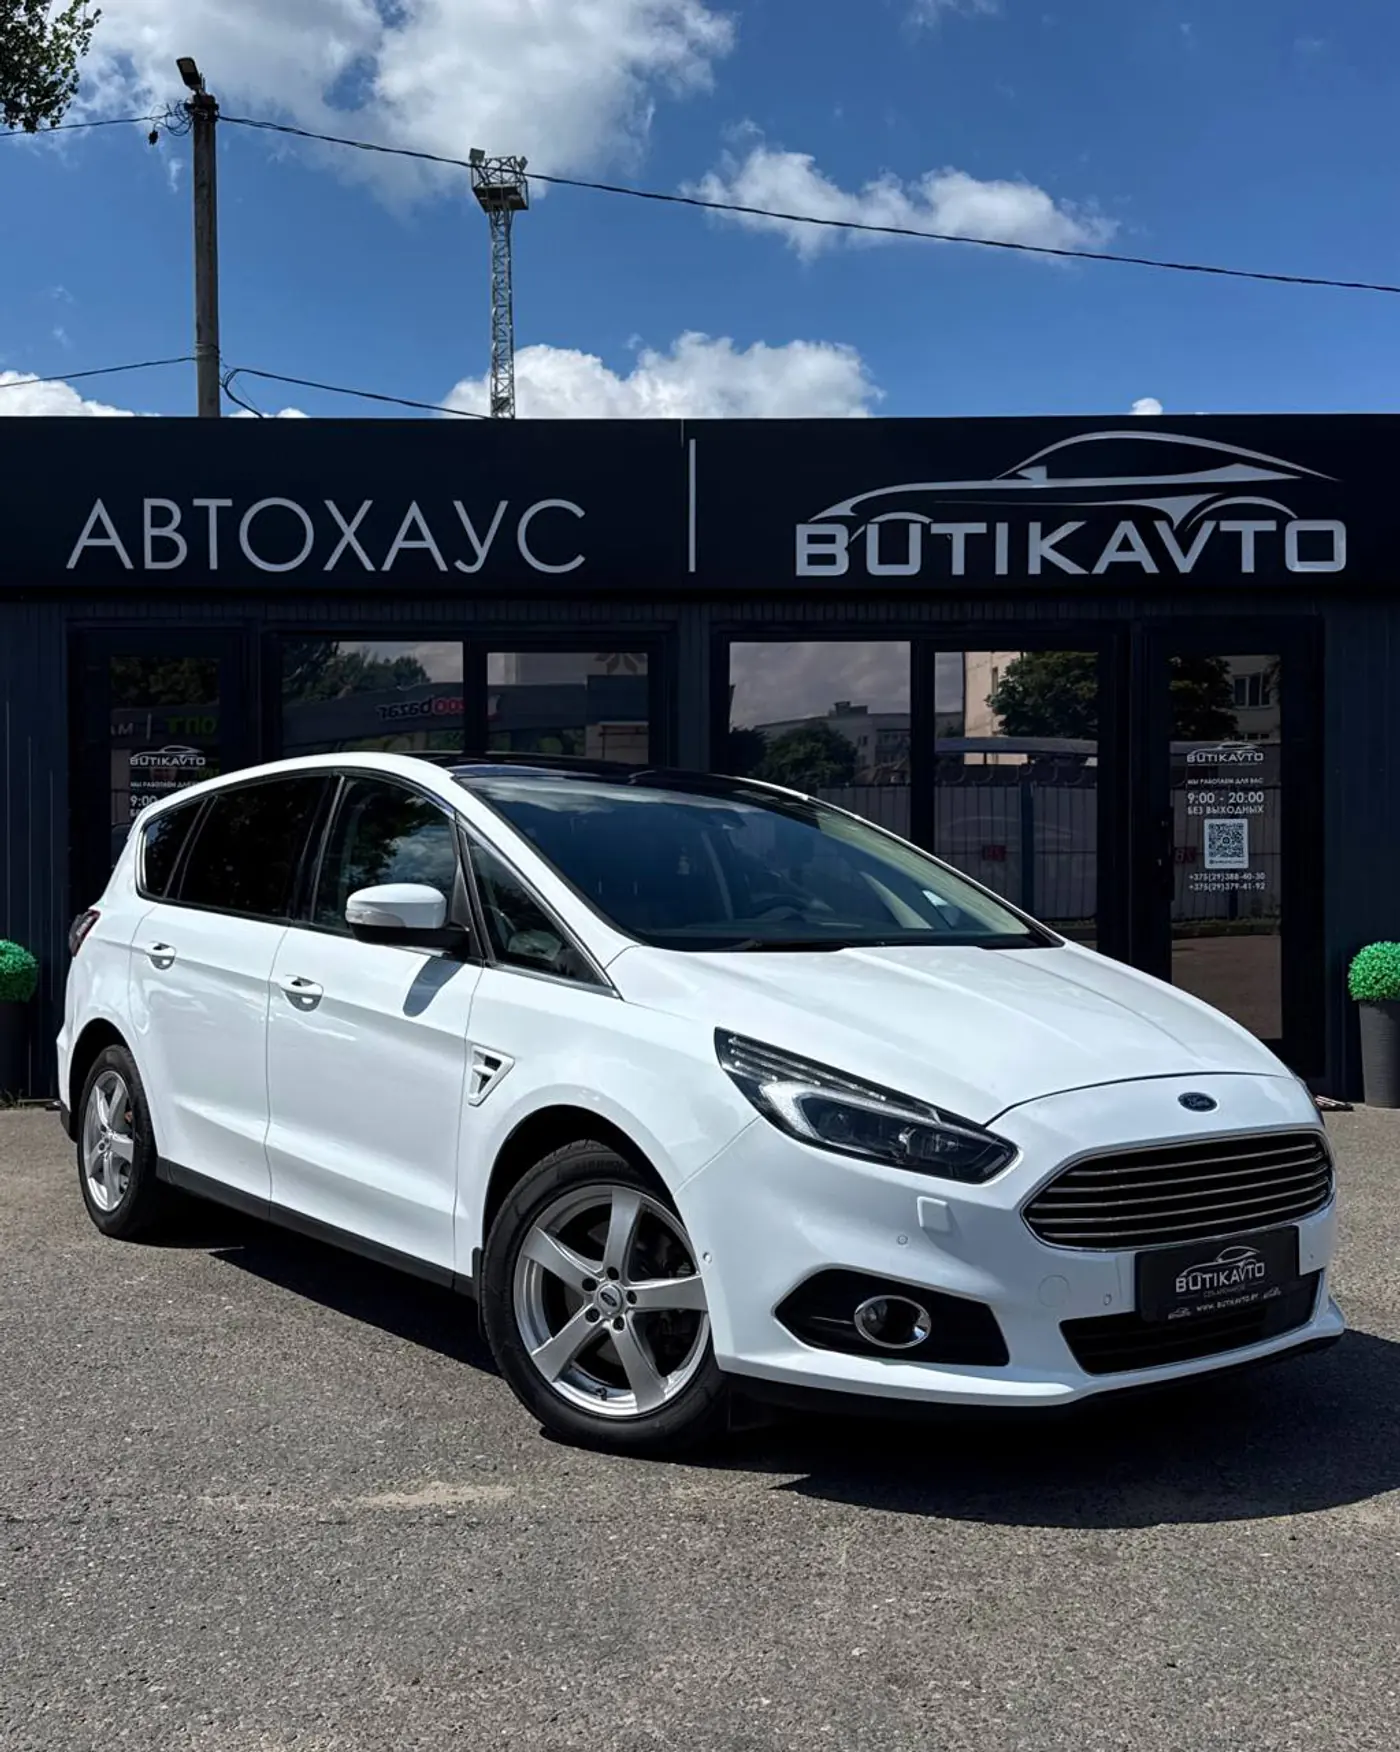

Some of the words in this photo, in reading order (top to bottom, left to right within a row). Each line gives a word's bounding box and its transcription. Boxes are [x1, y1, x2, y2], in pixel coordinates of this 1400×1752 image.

[66, 497, 586, 573] АВТОХАУС
[795, 519, 1347, 577] BUTIKAVTO
[130, 757, 206, 766] BUTIKAVTO
[1186, 752, 1264, 763] BUTIKAVTO
[1187, 792, 1215, 805] 9:00
[1228, 791, 1265, 804] 20:00
[1205, 805, 1265, 815] ВЫХОДНЫХ
[1175, 1262, 1265, 1293] BUTIKAVTO
